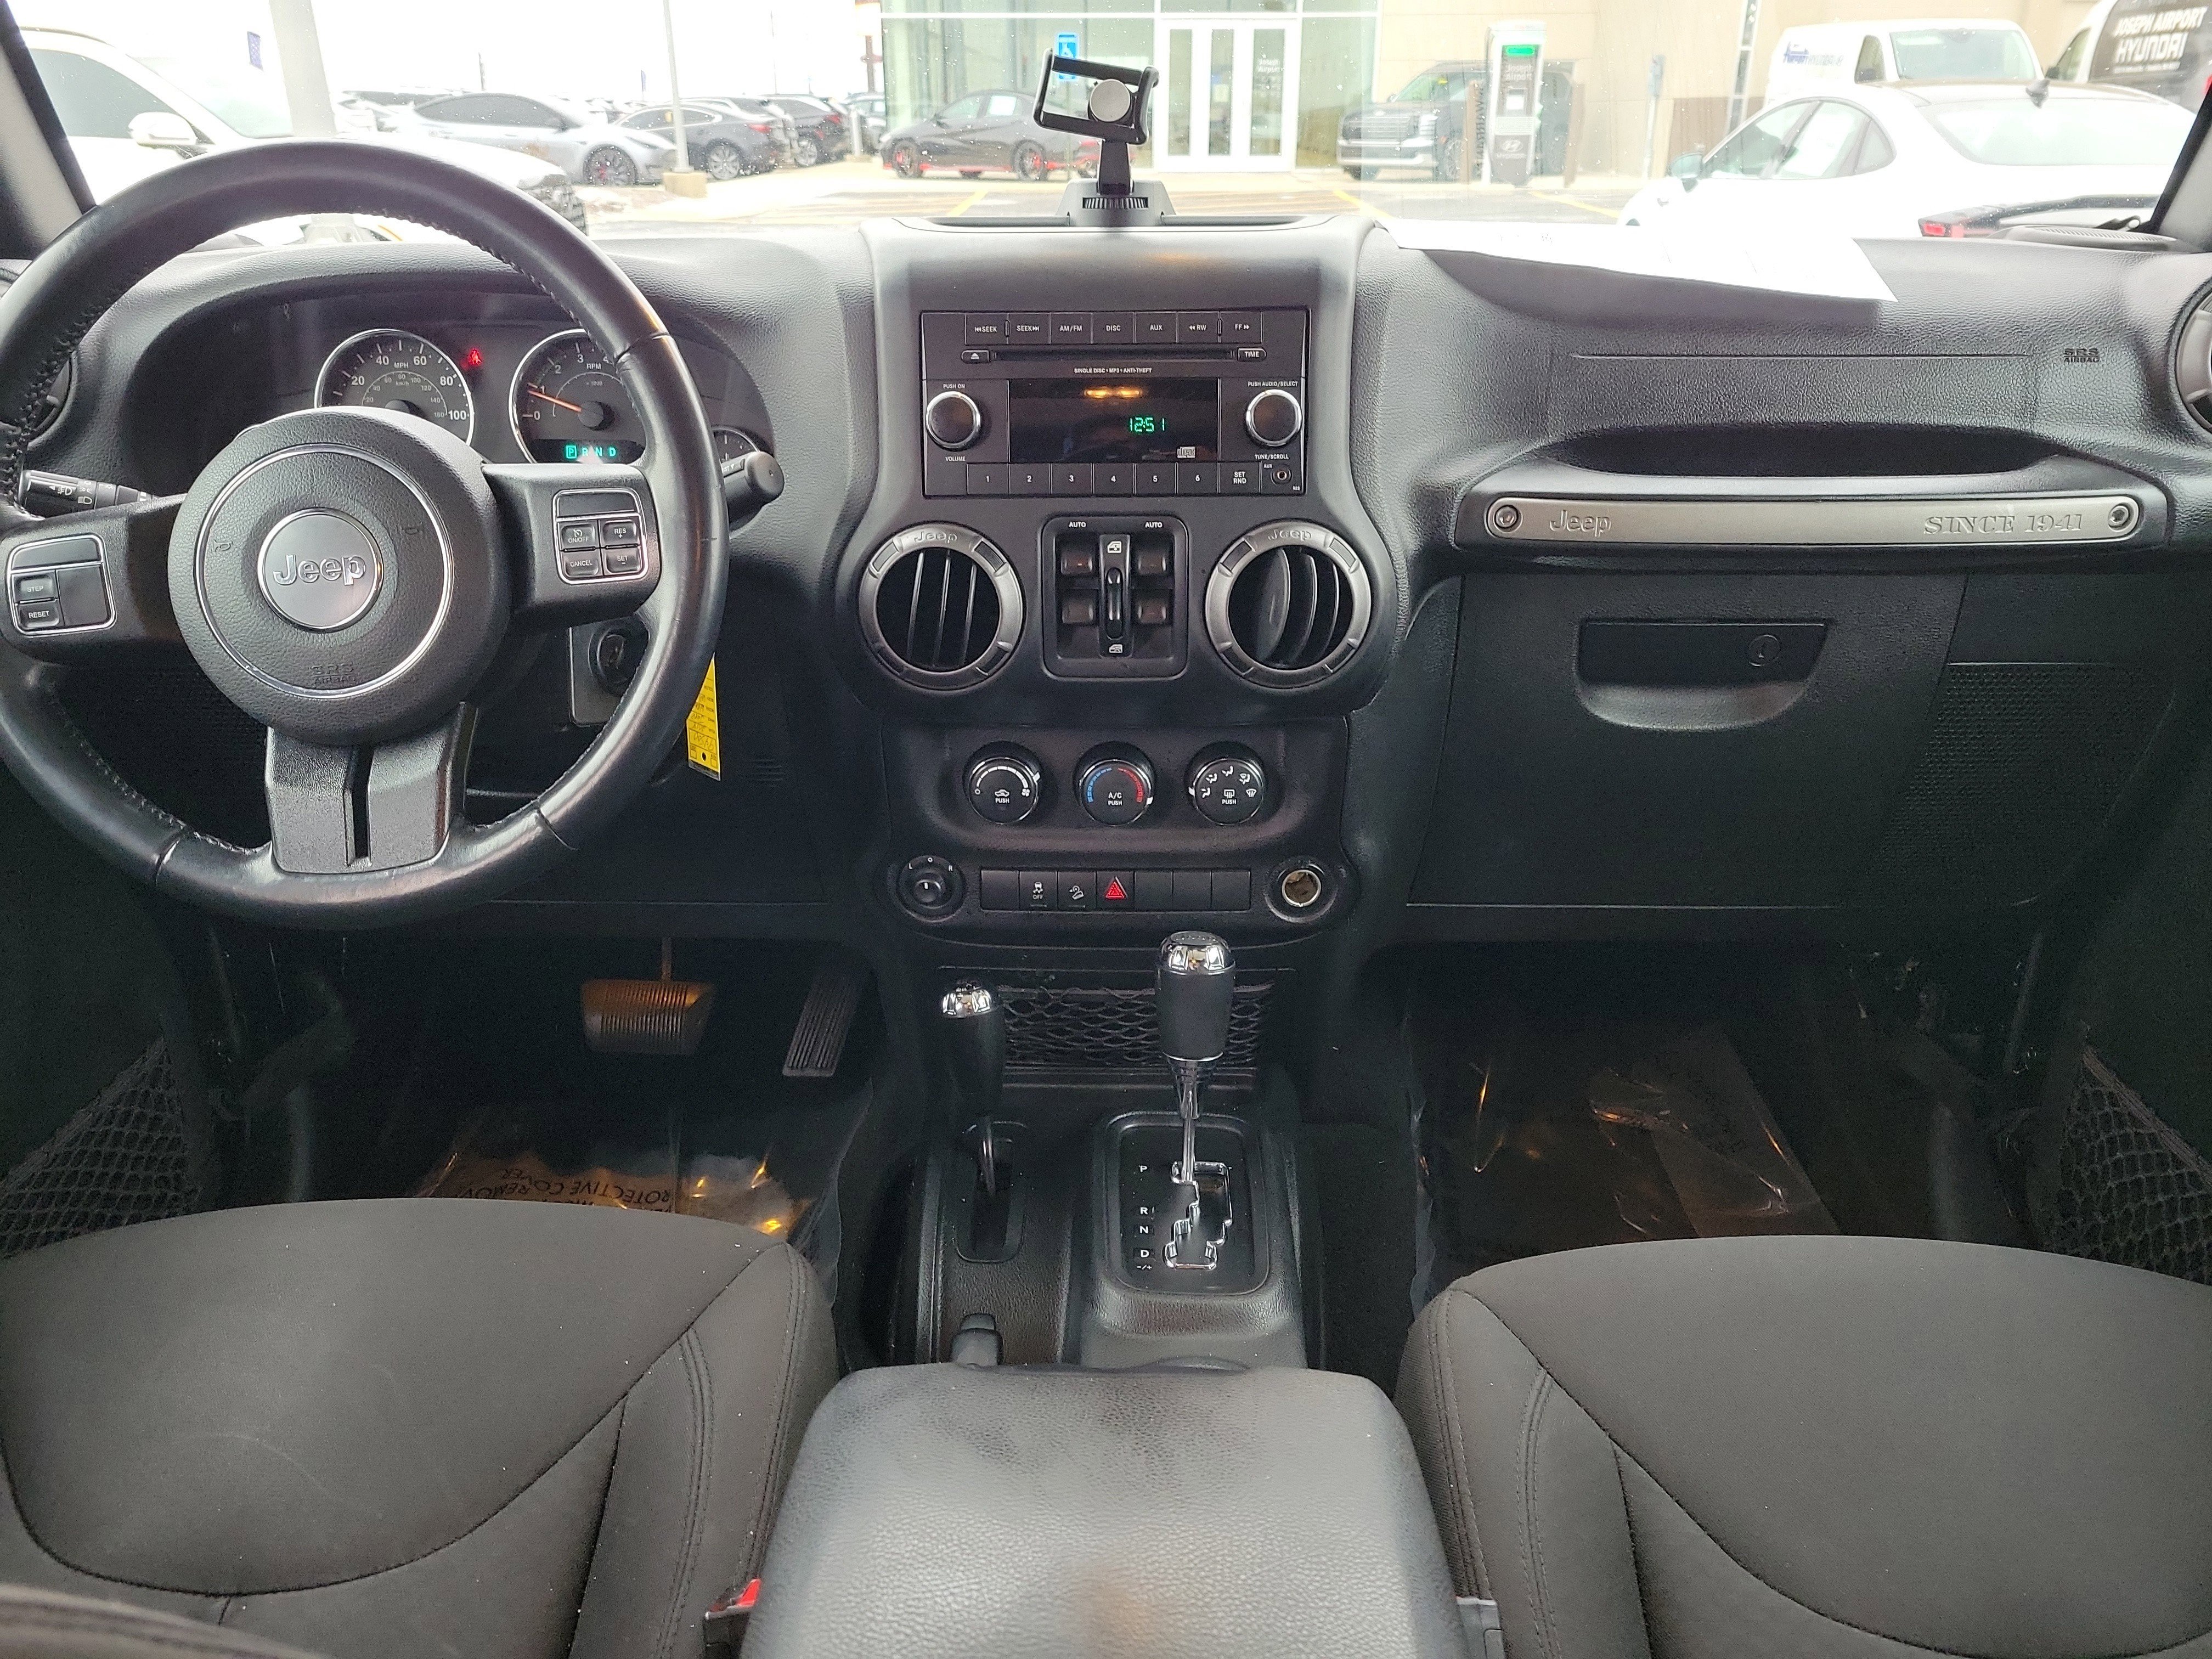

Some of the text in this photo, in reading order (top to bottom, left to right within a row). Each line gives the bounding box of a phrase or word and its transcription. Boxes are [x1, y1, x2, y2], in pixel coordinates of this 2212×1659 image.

[2113, 6, 2209, 37] JOSEPH AIRPORT
[2115, 32, 2189, 64] HYUNDAI
[376, 356, 390, 365] 40
[414, 356, 427, 366] 60
[577, 354, 584, 363] 3
[555, 365, 561, 374] 2
[352, 376, 365, 386] 20
[439, 376, 453, 386] 80
[449, 410, 466, 420] 100
[534, 411, 540, 420] 0
[1130, 417, 1165, 432] 12:51
[582, 448, 589, 456] R
[595, 448, 603, 456] N
[609, 448, 617, 456] D
[1550, 510, 1611, 537] Jeep
[1923, 514, 2082, 534] SINCE 1941
[914, 530, 957, 544] Jeep
[1268, 529, 1312, 541] Jeep
[273, 554, 366, 586] Jeep
[29, 610, 50, 618] RESET
[310, 663, 353, 674] SRS
[1108, 792, 1122, 800] A/C
[460, 1182, 531, 1199] REMOV
[569, 1181, 672, 1205] ROTECTIVE
[1140, 1249, 1149, 1258] D
